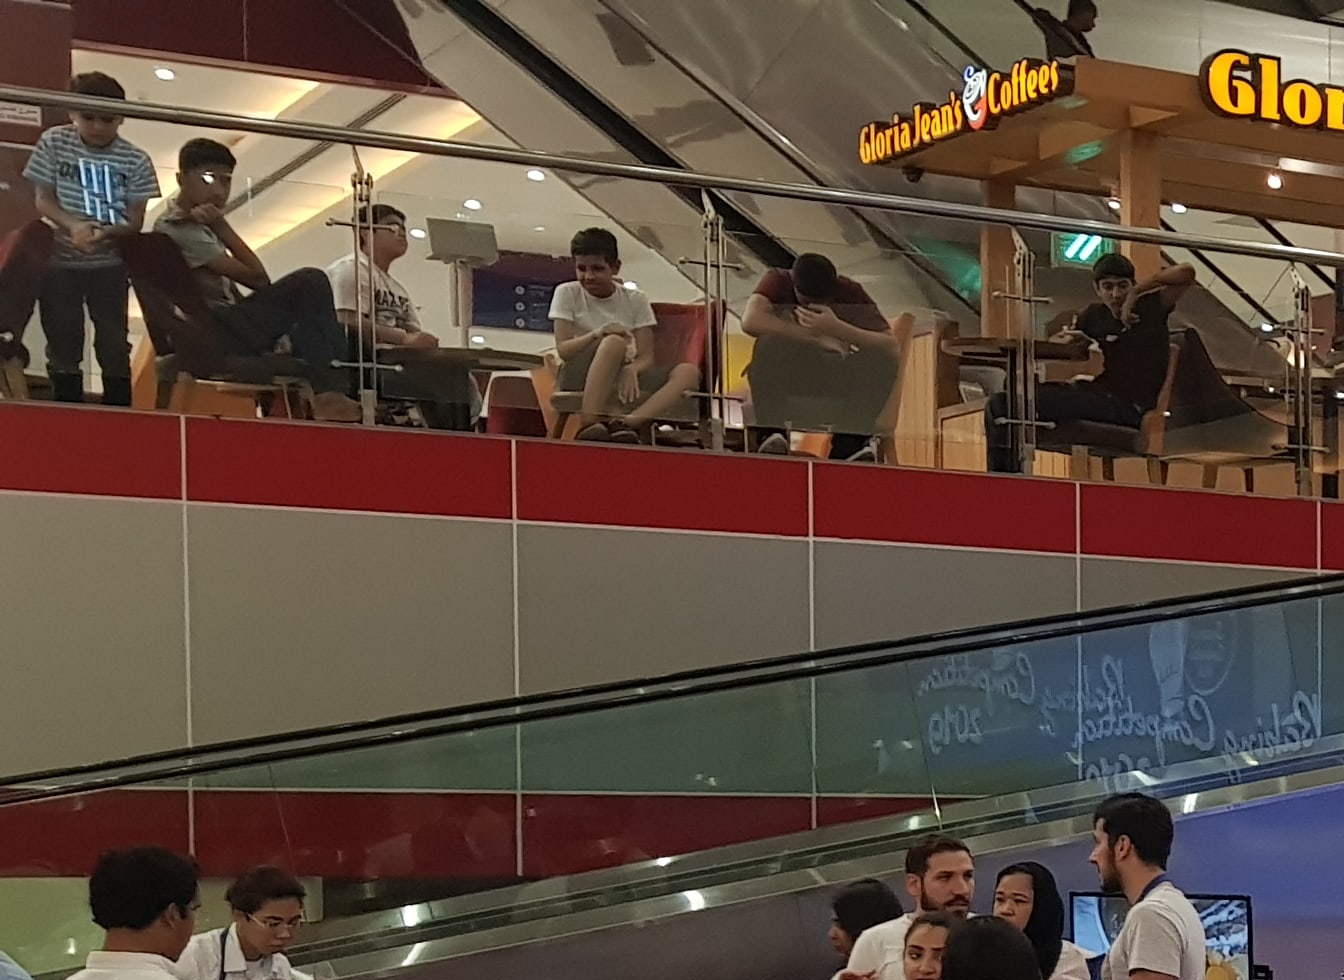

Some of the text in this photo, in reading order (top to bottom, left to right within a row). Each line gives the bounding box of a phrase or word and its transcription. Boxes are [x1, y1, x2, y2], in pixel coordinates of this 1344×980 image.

[858, 59, 1059, 165] Gloria Jean's Coffees
